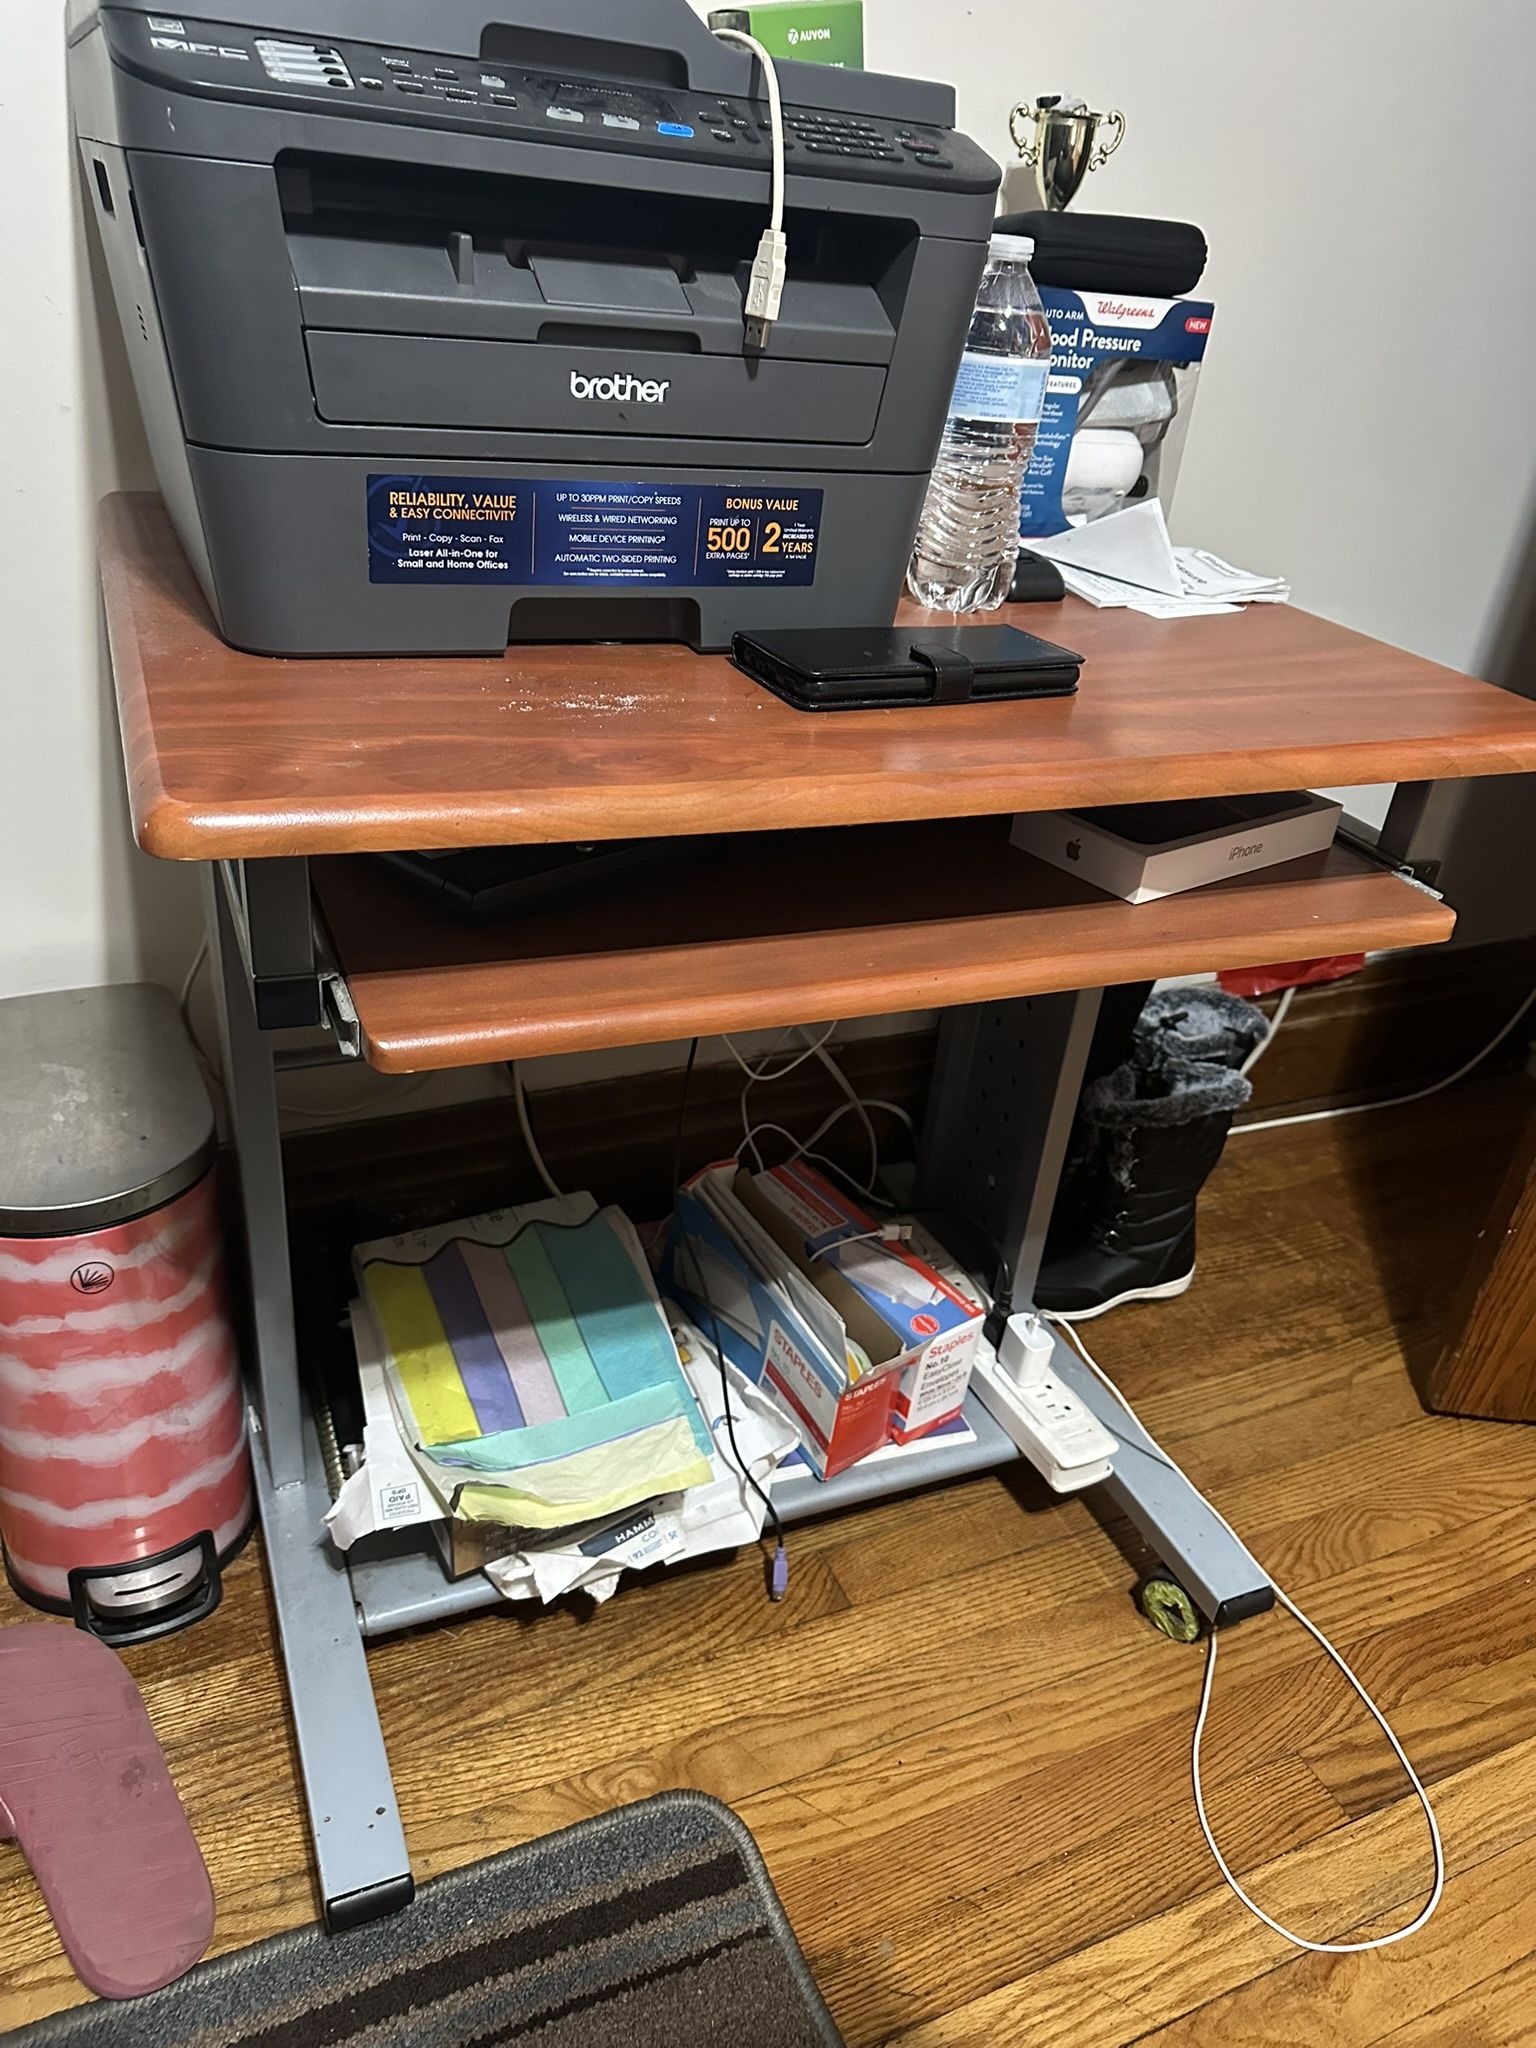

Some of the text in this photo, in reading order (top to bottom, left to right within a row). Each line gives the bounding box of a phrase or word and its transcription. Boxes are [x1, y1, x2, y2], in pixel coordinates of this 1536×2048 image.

[800, 28, 831, 42] AUVON
[150, 36, 250, 61] MFC
[1046, 309, 1084, 320] UTO ARM
[1097, 301, 1155, 320] Walgreens
[1189, 320, 1208, 330] NEW
[1049, 326, 1142, 352] lood Pressure
[1050, 349, 1094, 370] onitor
[570, 371, 670, 402] brother
[389, 491, 517, 509] RELIABILITY, VALUE
[556, 493, 682, 506] UP TO 30PPM PRINT/COPY SPEEDS
[726, 498, 799, 511] BONUS VALUE
[389, 508, 516, 521] & EASY CONNECTIVITY
[558, 514, 678, 525] WIRELESS & WIRED NETWORKING
[709, 518, 751, 527] PRINT UP TO
[402, 533, 421, 542] Print
[429, 533, 453, 544] Copy
[460, 534, 482, 543] Scan
[489, 535, 504, 543] Fax
[569, 534, 597, 543] MOBILE
[599, 534, 626, 543] DEVICE
[707, 527, 751, 552] 500
[762, 522, 782, 553] 2
[408, 548, 498, 558] Laser All-in-One for
[781, 542, 814, 553] YEARS
[554, 554, 677, 564] AUTOMATIC TWO-SIDED PRINTING
[706, 552, 726, 560] EXTRA
[397, 559, 508, 570] Small and Home Offices
[1228, 843, 1264, 861] iPhone
[929, 1331, 974, 1359] Staples
[774, 1327, 824, 1399] STAPLES
[844, 1378, 888, 1402] STAPLES
[388, 1493, 411, 1503] PAID
[614, 1516, 655, 1544] HAMM
[632, 1550, 645, 1560] 92
